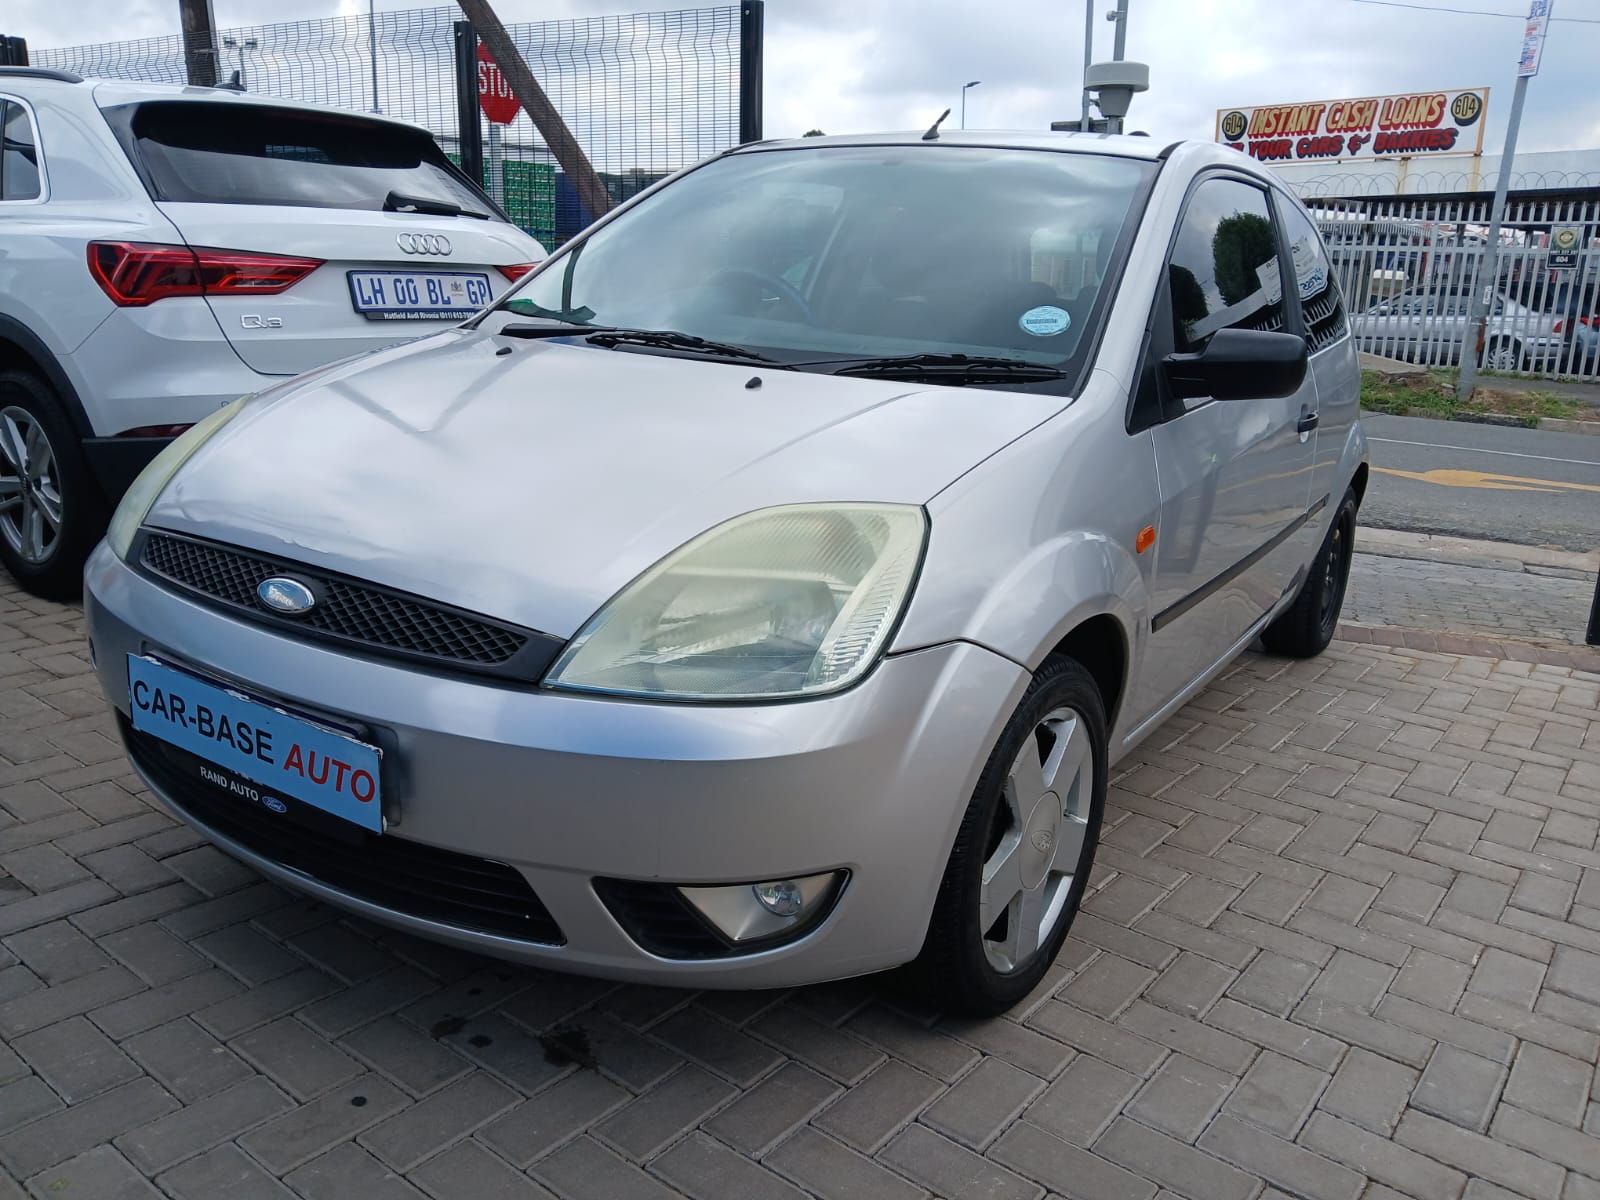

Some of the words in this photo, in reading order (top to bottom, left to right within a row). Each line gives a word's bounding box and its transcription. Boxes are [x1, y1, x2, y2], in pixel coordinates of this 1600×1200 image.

[1247, 104, 1325, 138] INSTANT
[1326, 99, 1379, 132] CASH
[1378, 93, 1447, 129] LOANS
[1454, 97, 1476, 116] 604
[1225, 114, 1242, 133] 604
[1248, 139, 1293, 161] YOUR
[1296, 135, 1344, 159] CARS
[1373, 128, 1459, 154] BAKKIES
[357, 277, 386, 305] LH
[426, 278, 451, 305] BL
[466, 279, 487, 305] GP
[241, 314, 283, 329] Q3
[133, 680, 274, 765] CAR-BASE
[283, 743, 376, 803] AUTO
[200, 766, 228, 788] RAND
[230, 780, 259, 801] AUTO
